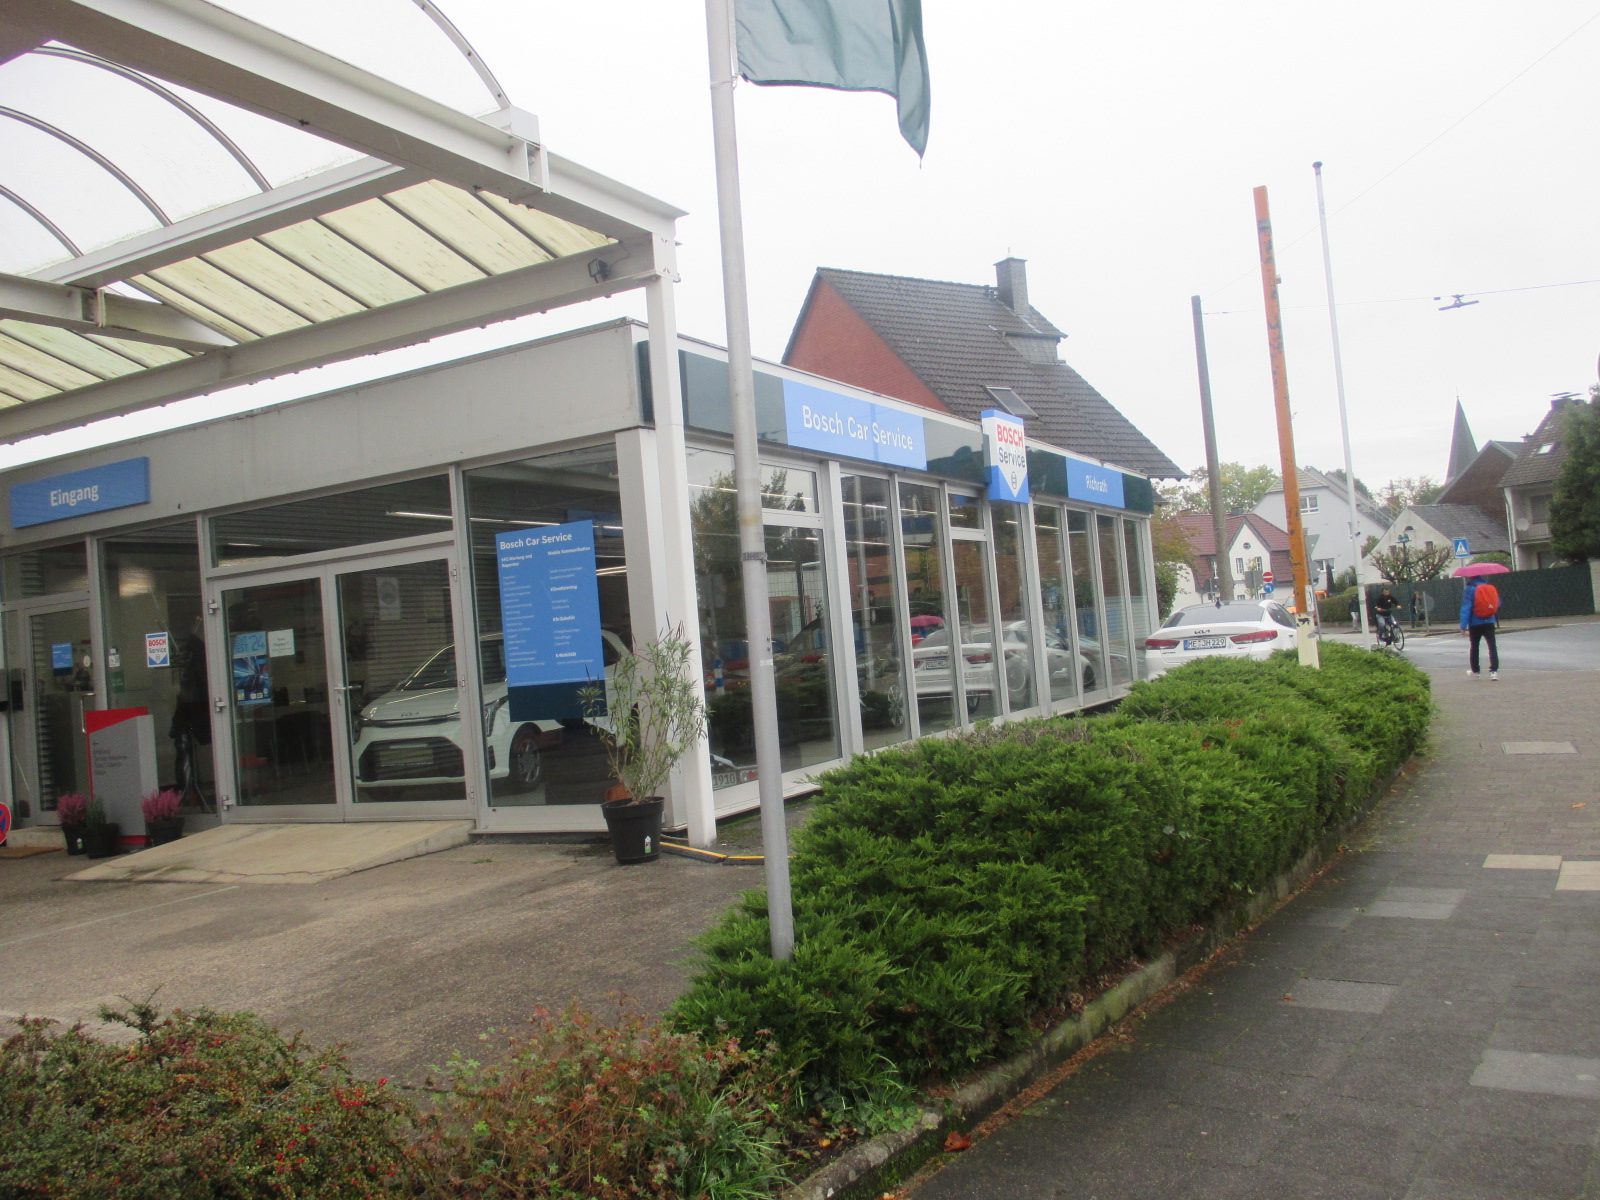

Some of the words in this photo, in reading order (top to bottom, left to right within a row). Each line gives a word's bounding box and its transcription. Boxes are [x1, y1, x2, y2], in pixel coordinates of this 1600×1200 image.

[802, 405, 844, 435] Bosch
[847, 416, 869, 440] Car
[872, 422, 914, 451] Service
[996, 424, 1024, 448] BOSCH
[998, 447, 1026, 469] Service
[50, 485, 100, 507] Eingang
[500, 538, 524, 550] Bosch
[525, 537, 540, 547] Car
[541, 533, 573, 544] Service
[1212, 638, 1225, 646] 229
